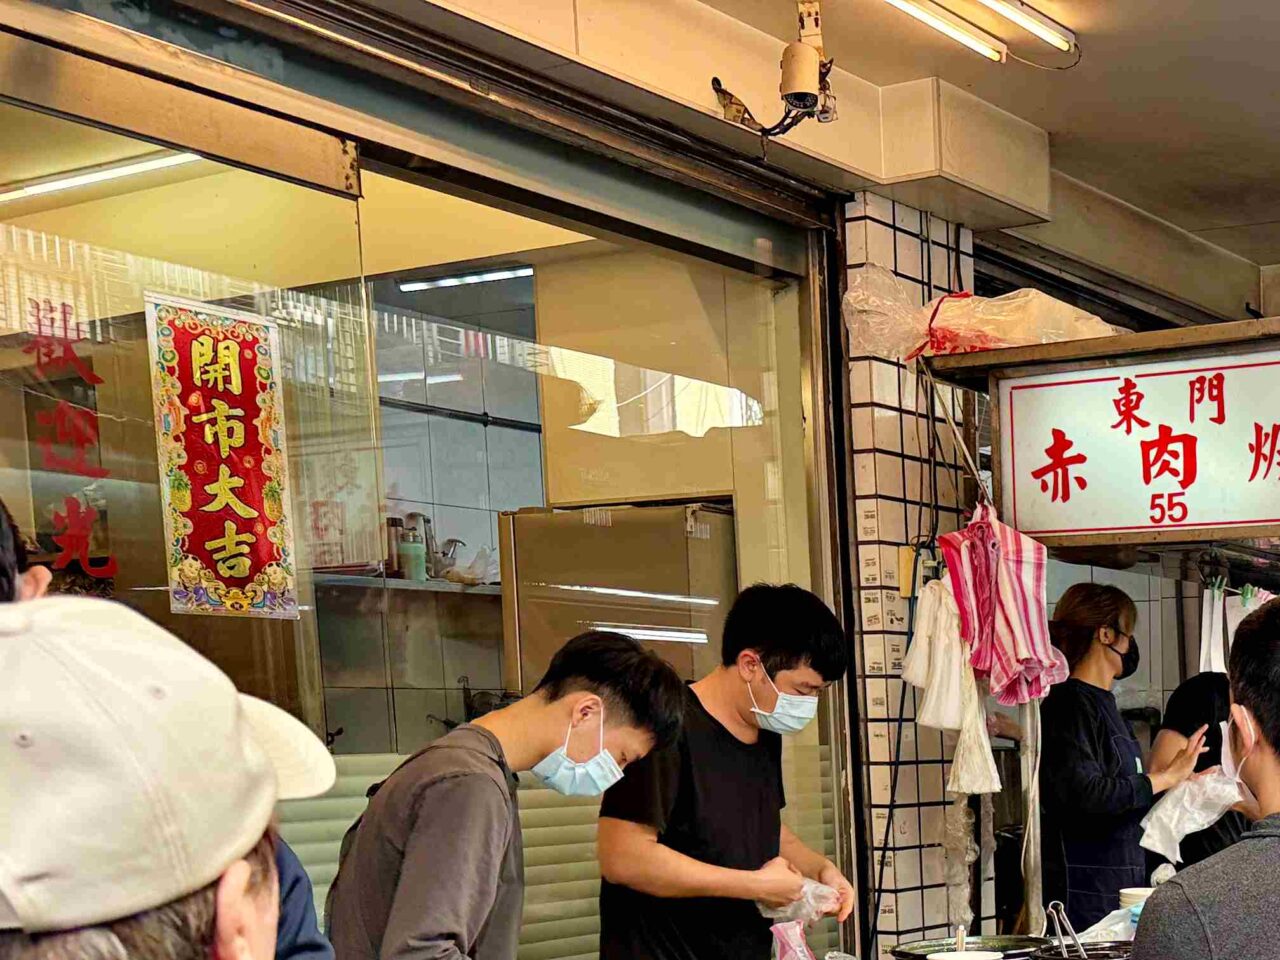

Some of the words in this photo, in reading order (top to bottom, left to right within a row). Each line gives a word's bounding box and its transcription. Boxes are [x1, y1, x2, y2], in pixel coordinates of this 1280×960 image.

[1111, 371, 1226, 436] 東門
[191, 334, 258, 580] 開市大吉
[1149, 491, 1188, 524] 55
